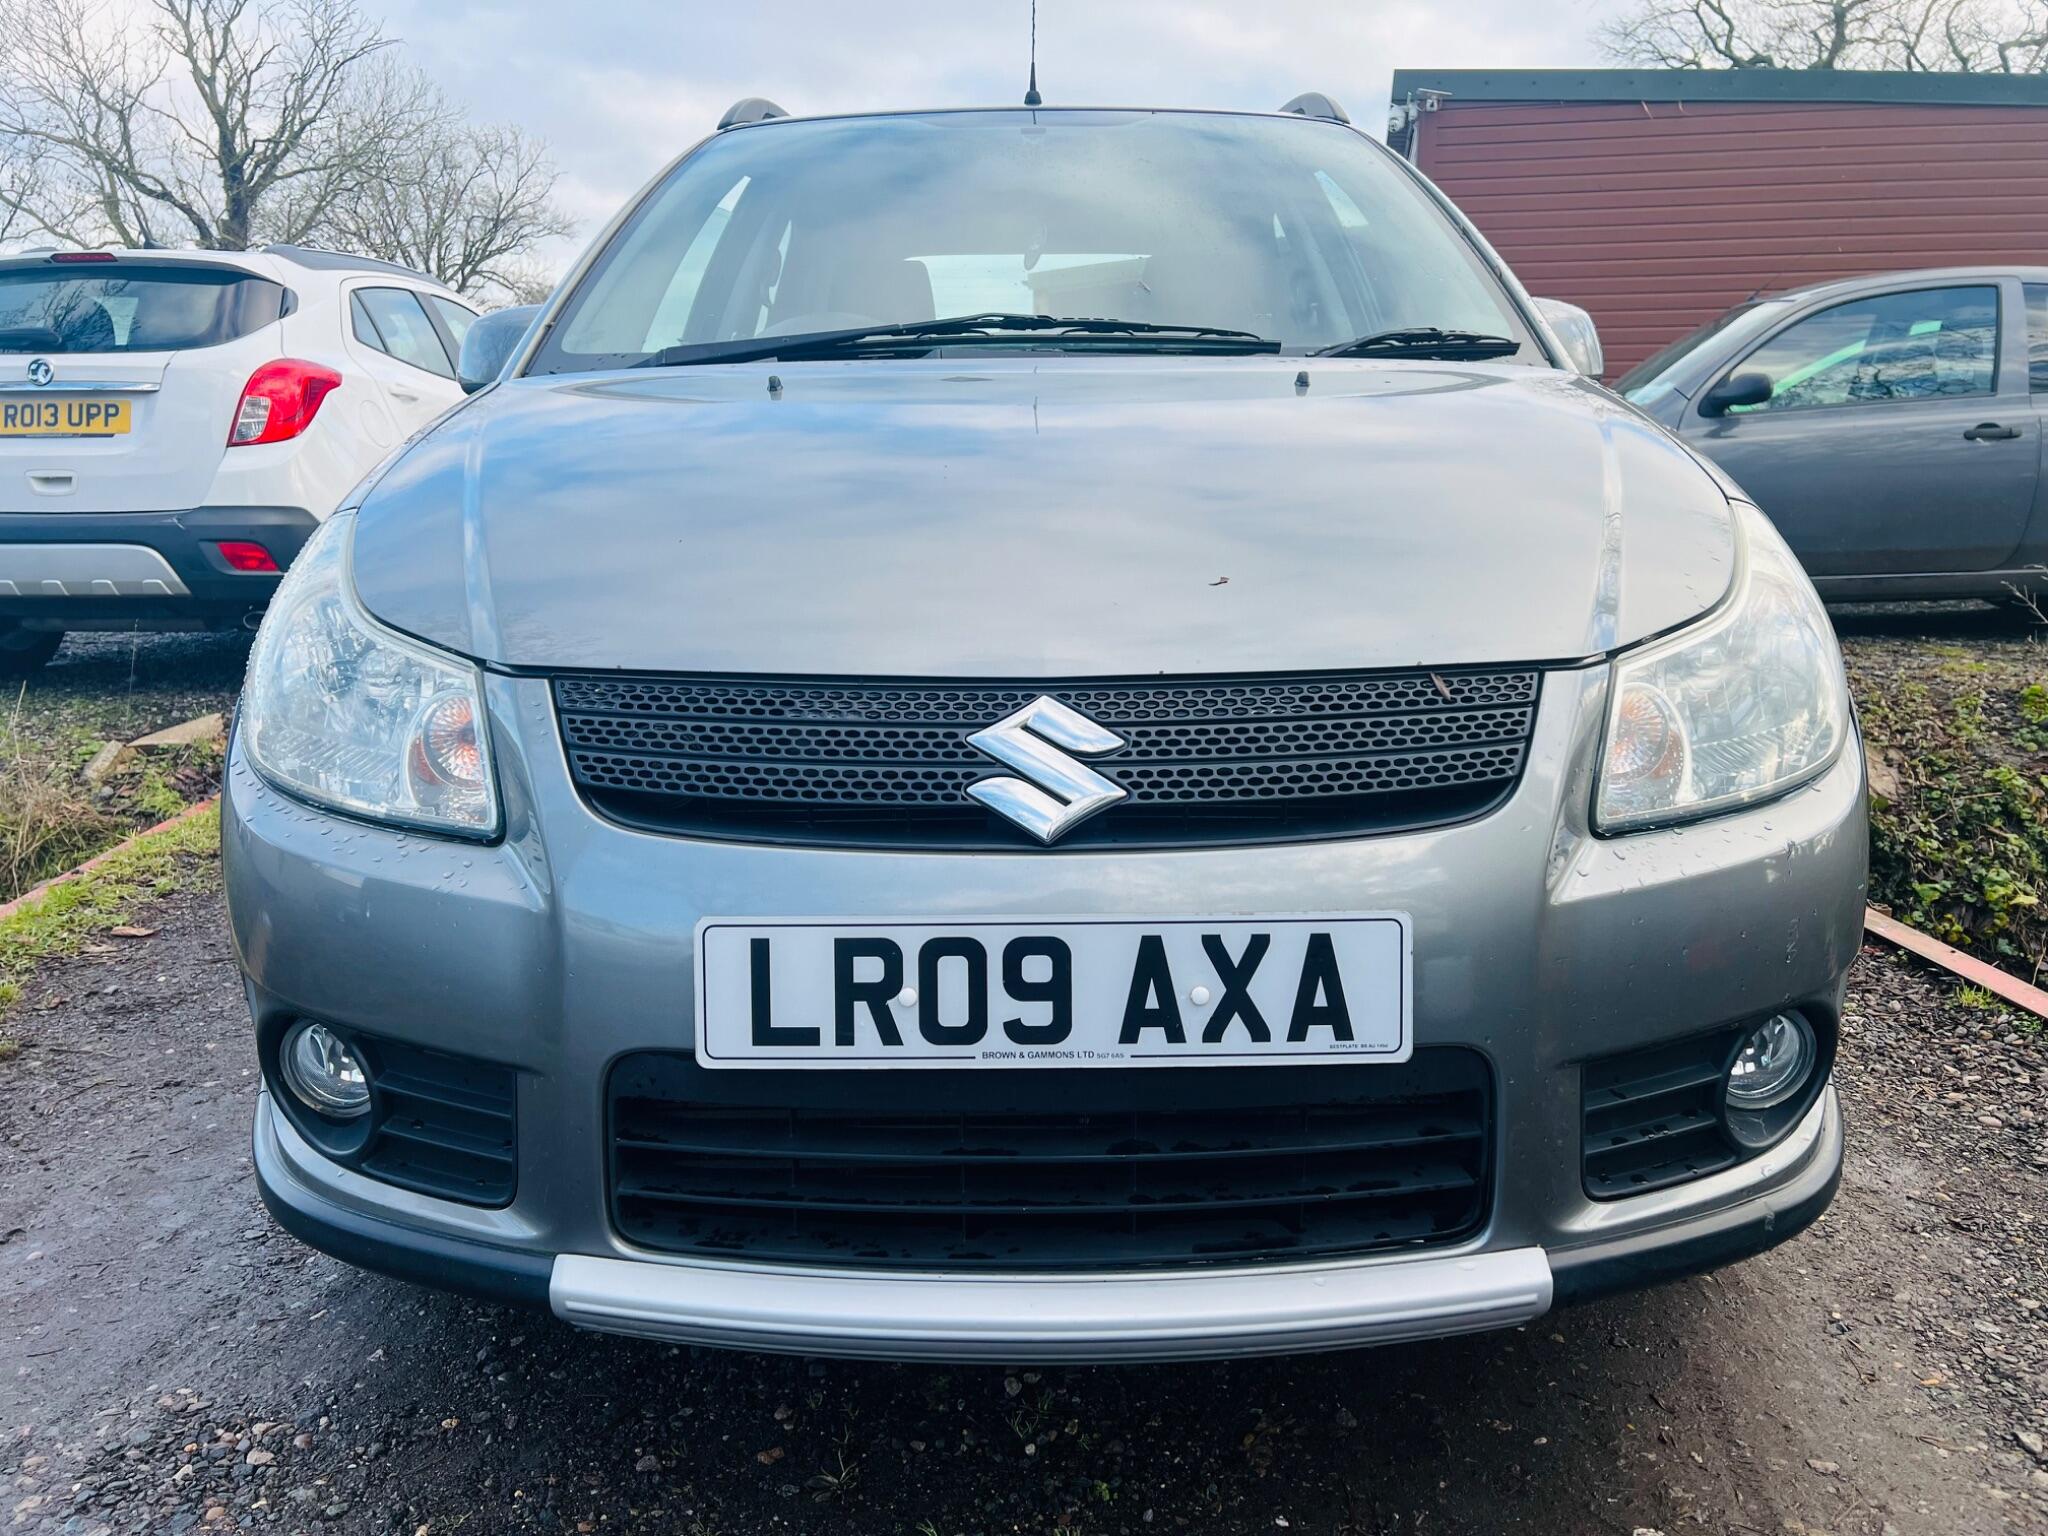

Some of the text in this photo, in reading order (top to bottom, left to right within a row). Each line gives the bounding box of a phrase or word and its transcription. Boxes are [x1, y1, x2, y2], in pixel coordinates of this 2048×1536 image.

[4, 403, 119, 428] RO13 UPP
[750, 932, 1355, 1047] LR09 AXA
[981, 1051, 1016, 1060] BROWN
[1018, 1051, 1025, 1059] &
[1027, 1051, 1075, 1059] GAMMONS
[1077, 1050, 1095, 1059] LTD
